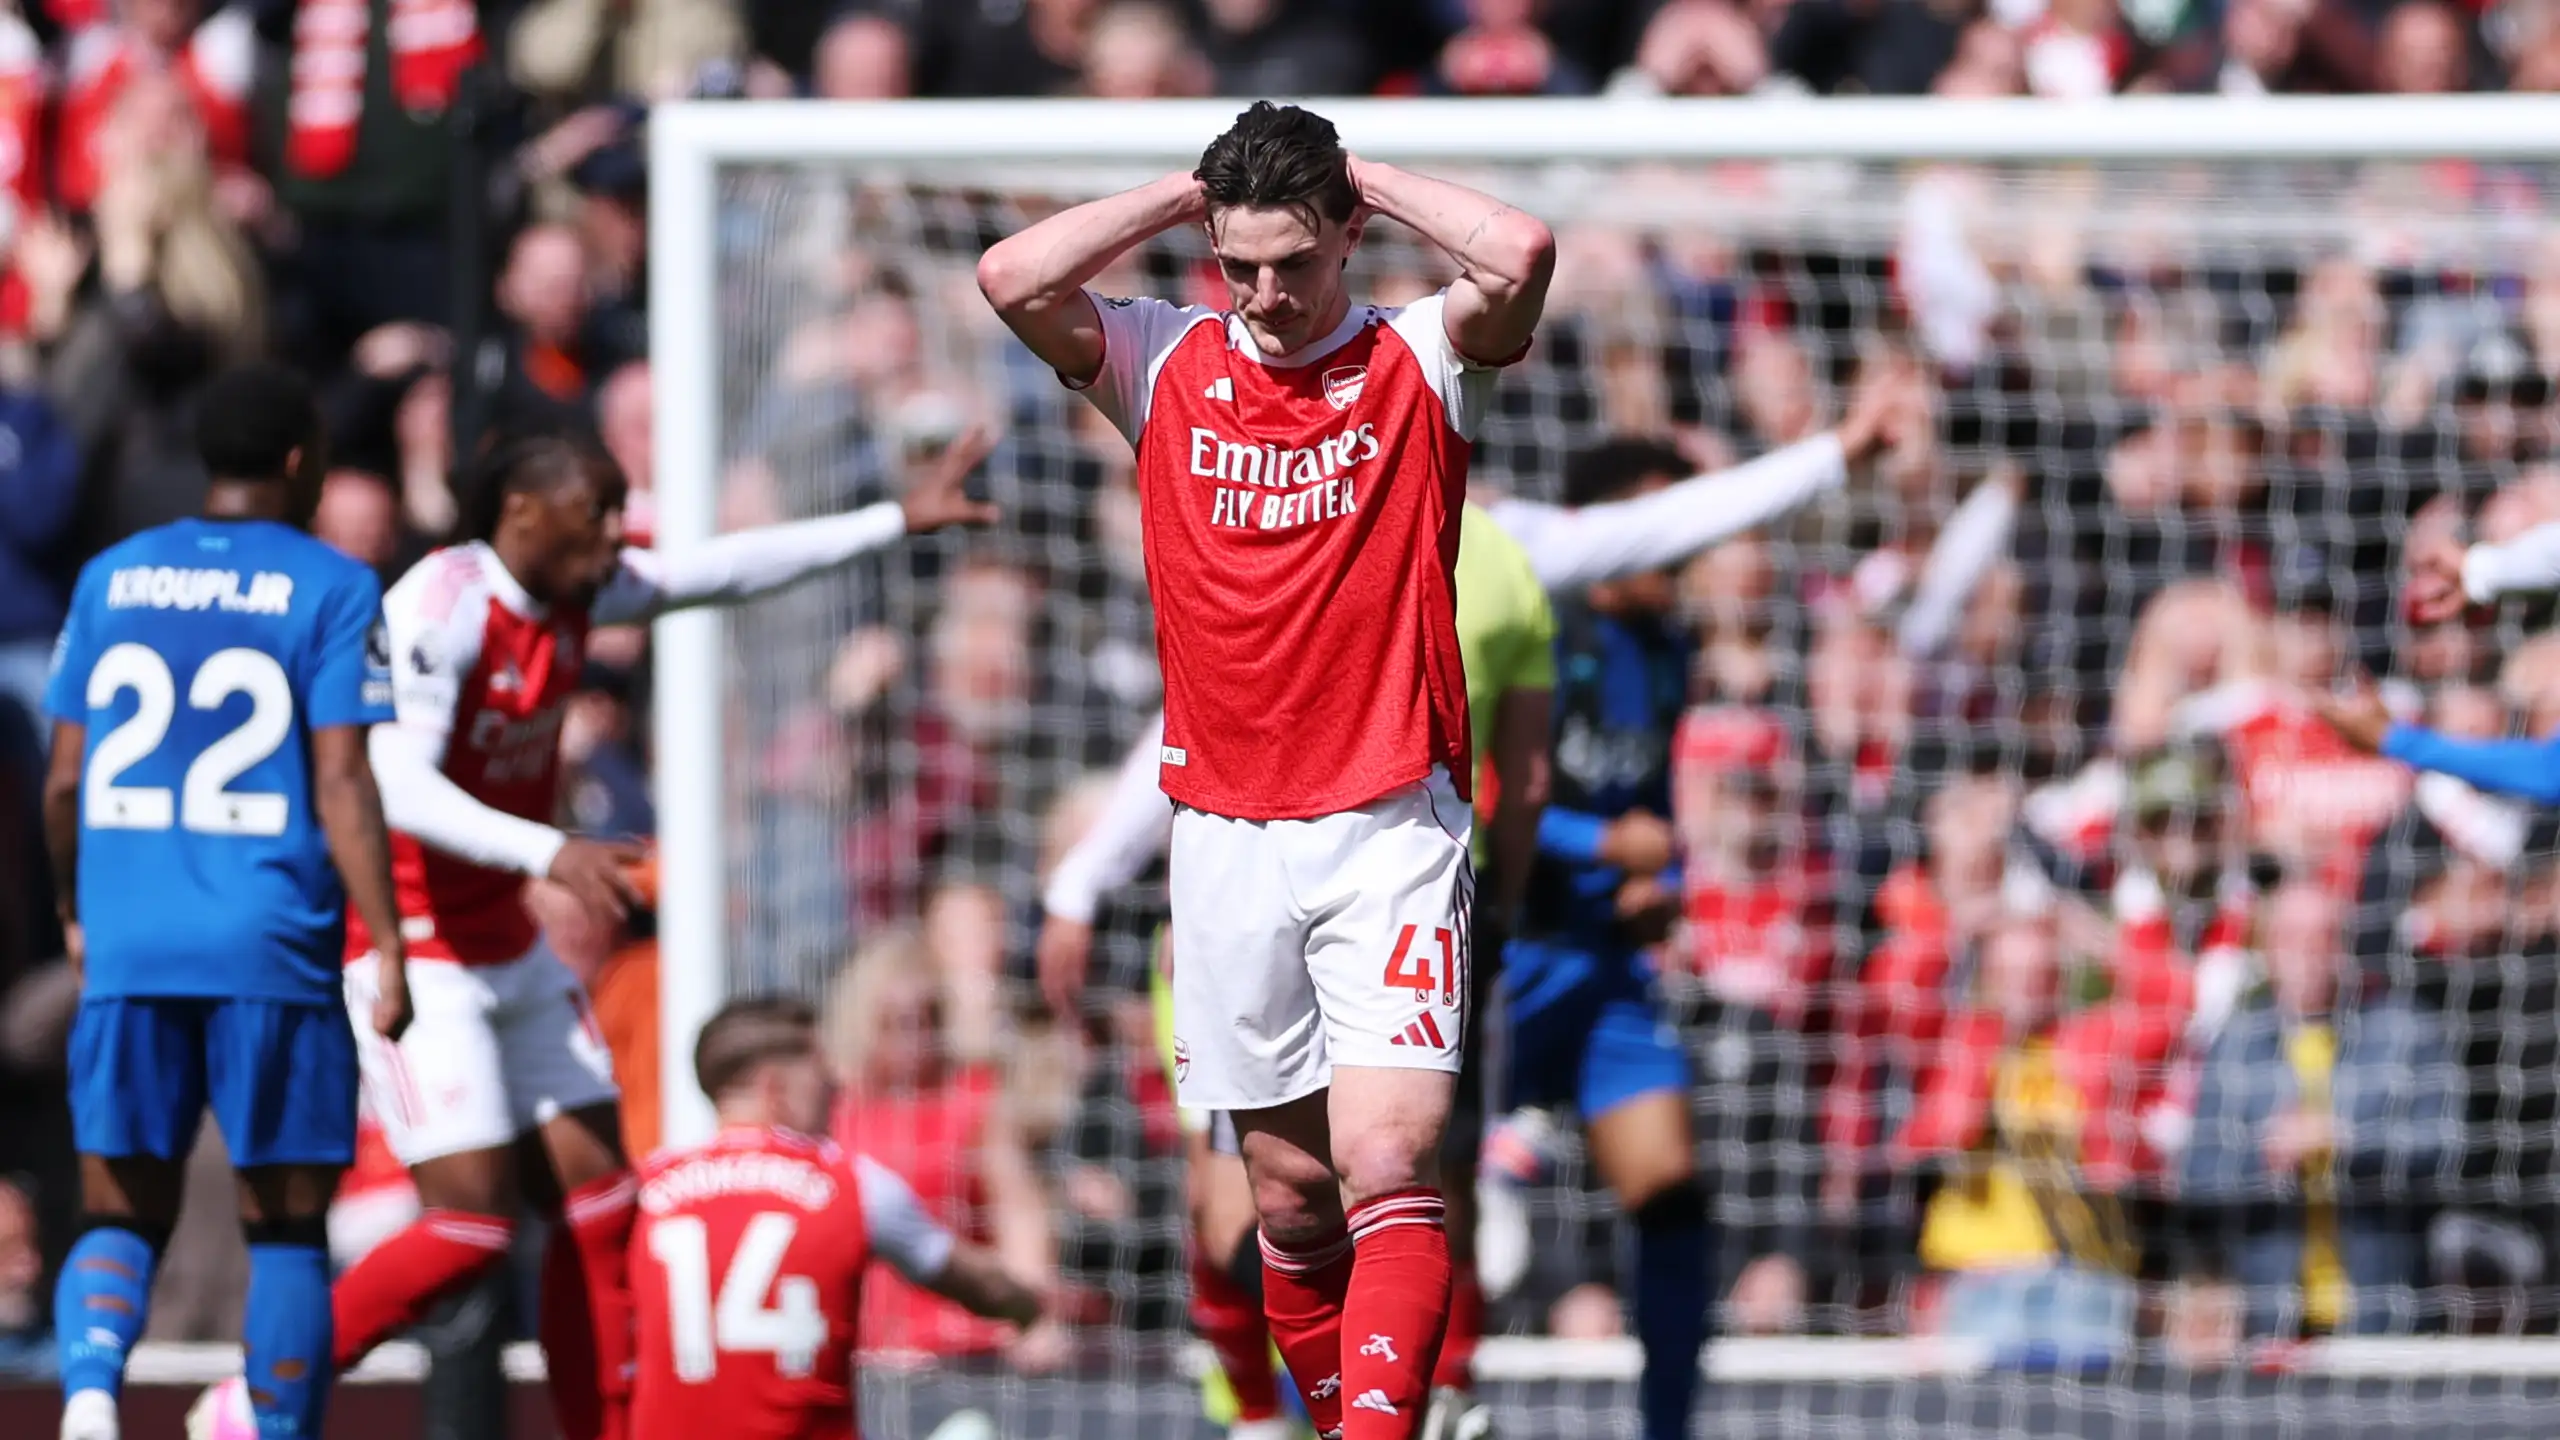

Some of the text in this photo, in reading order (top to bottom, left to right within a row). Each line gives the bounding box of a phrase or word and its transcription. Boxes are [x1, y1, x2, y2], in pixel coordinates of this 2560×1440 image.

[1189, 422, 1380, 489] Emirates
[1211, 476, 1358, 530] FLY BETTER
[86, 641, 293, 837] 22
[1383, 923, 1454, 1007] 41
[648, 1210, 830, 1386] 14
